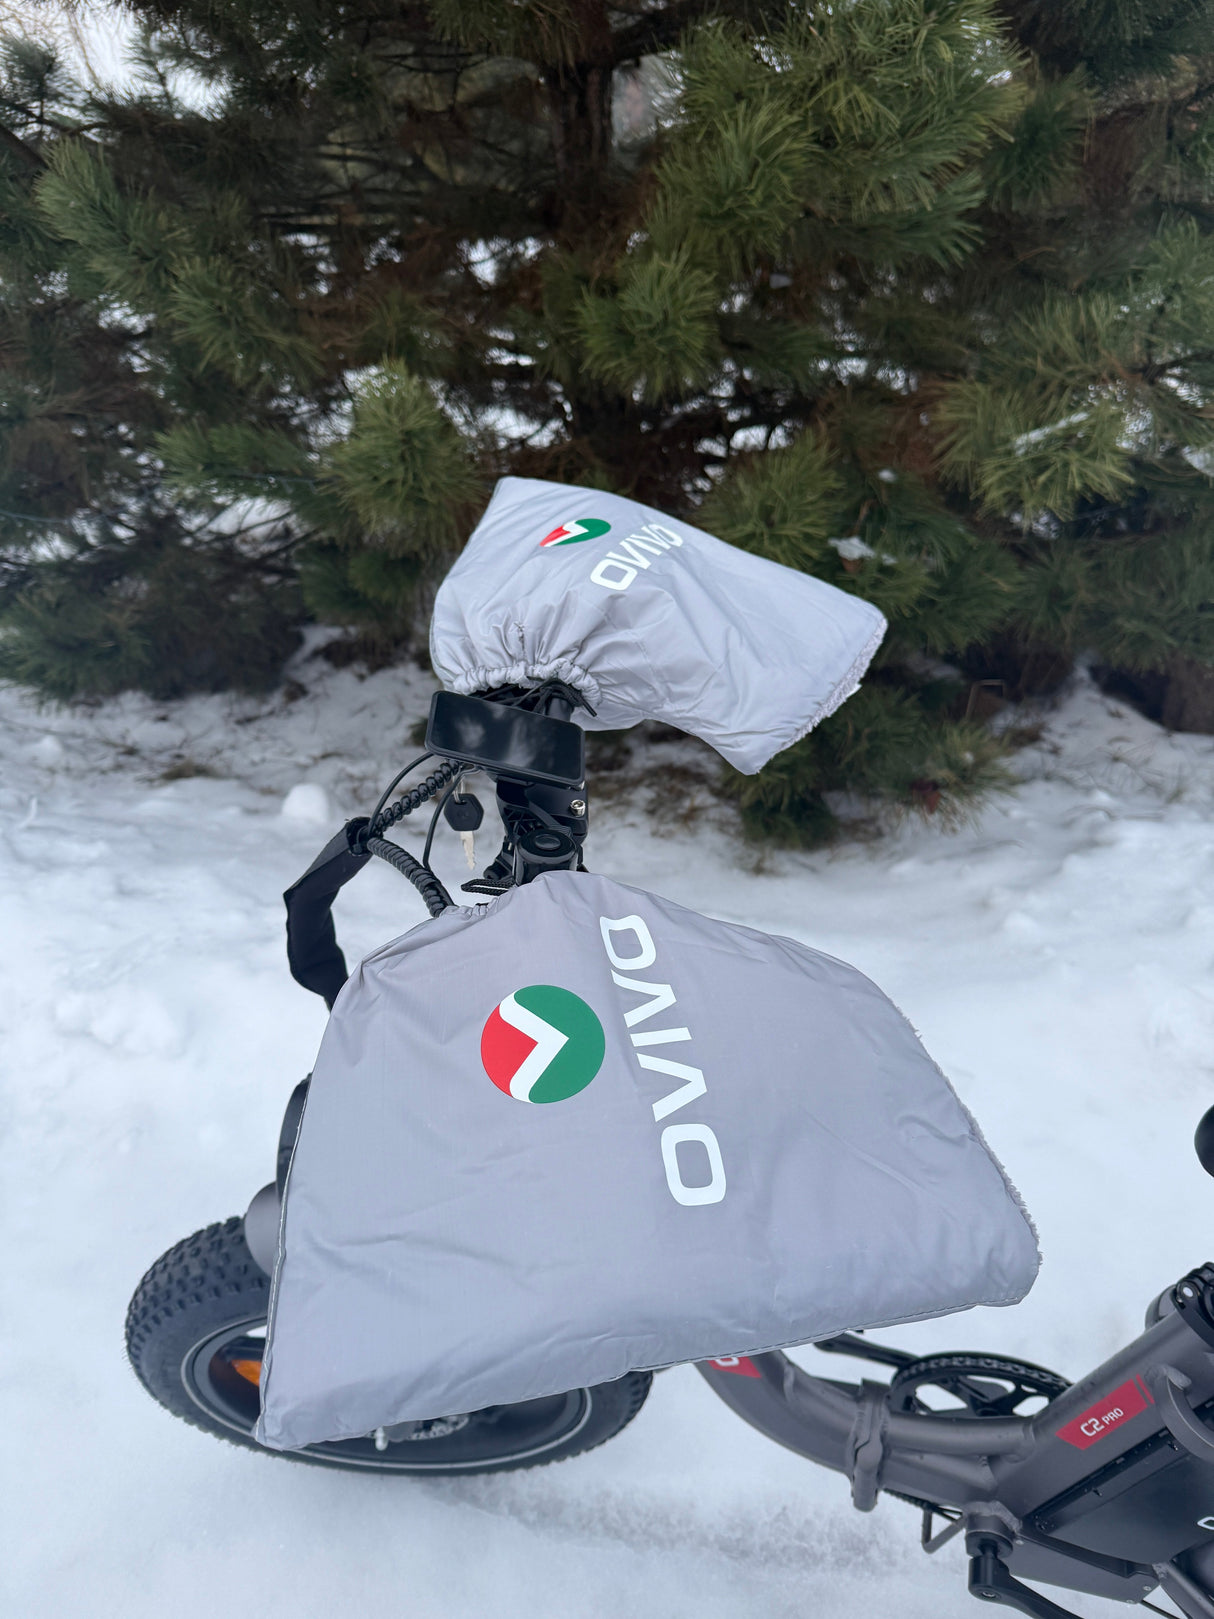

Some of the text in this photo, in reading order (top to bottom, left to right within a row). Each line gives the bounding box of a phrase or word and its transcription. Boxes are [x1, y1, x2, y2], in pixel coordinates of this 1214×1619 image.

[590, 524, 683, 591] OVIVO
[600, 915, 727, 1207] OVIVO
[1080, 1408, 1124, 1437] C2 PRO
